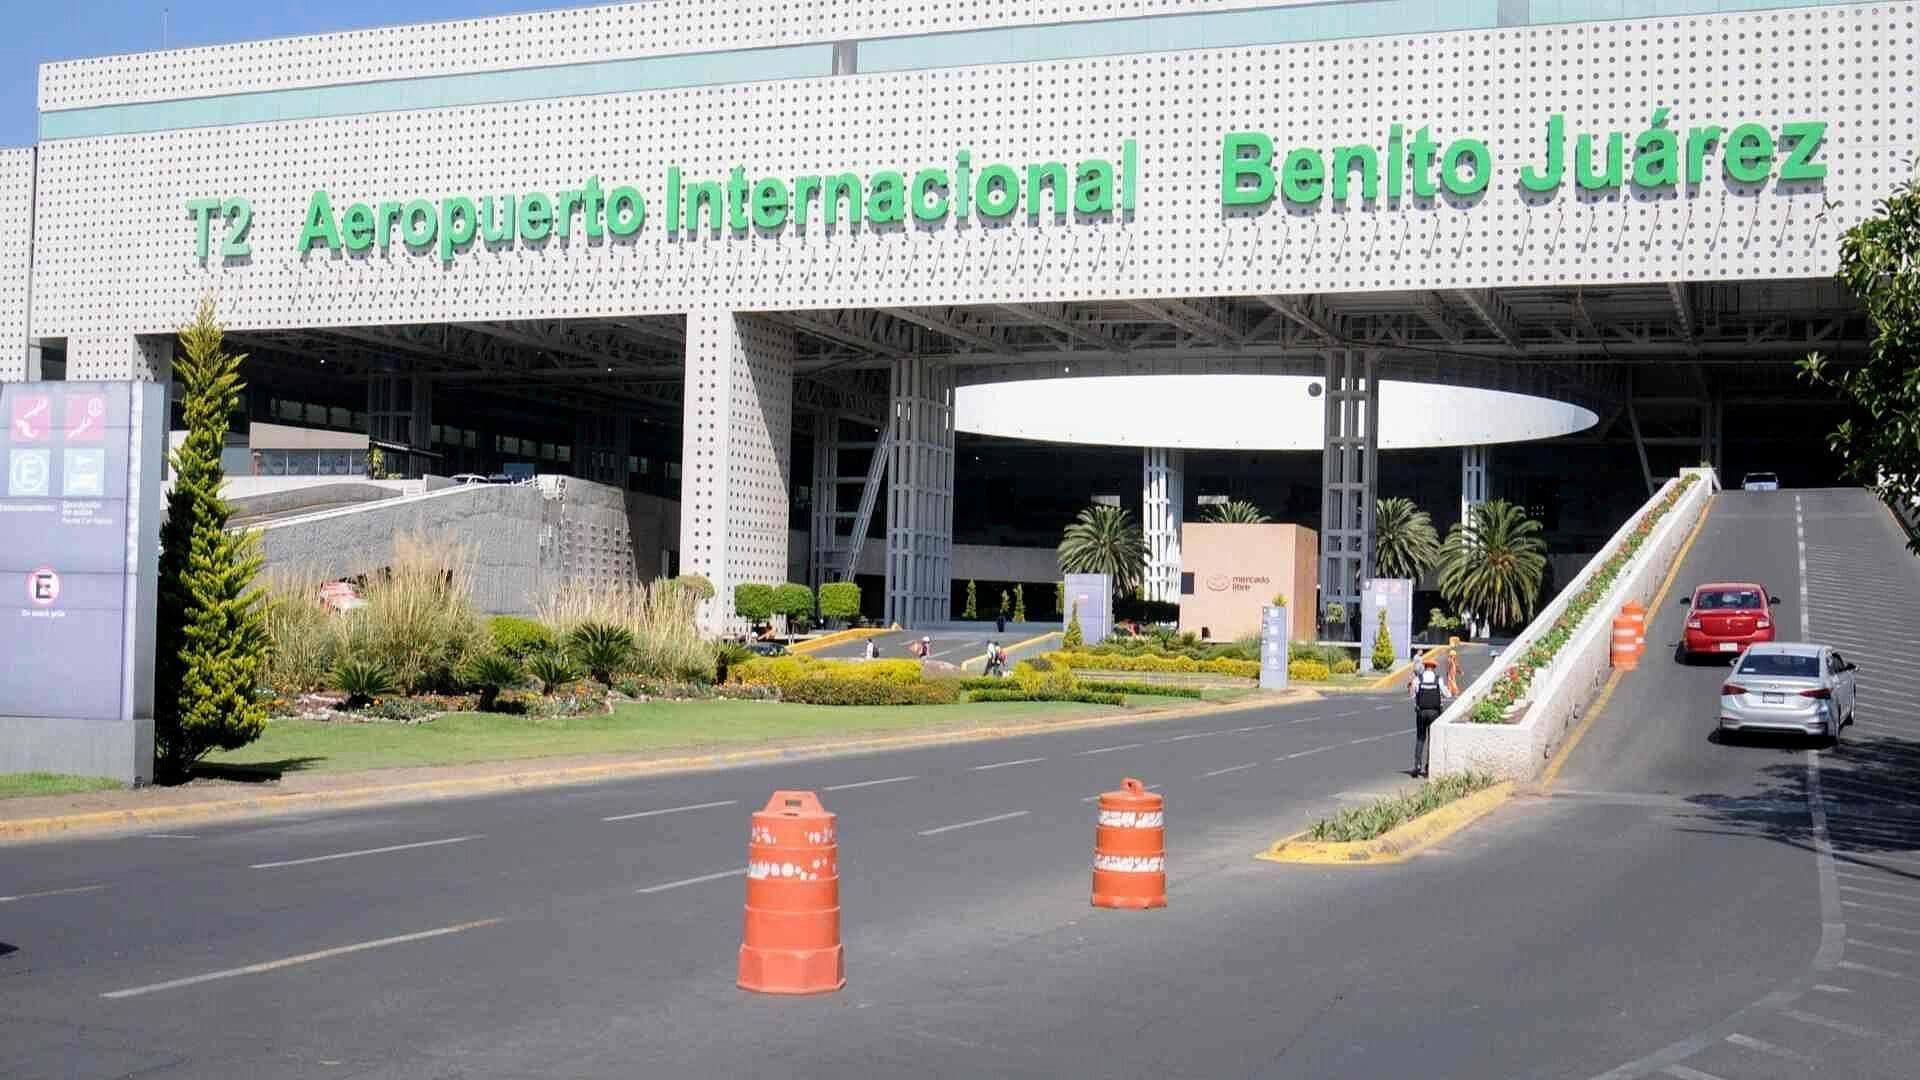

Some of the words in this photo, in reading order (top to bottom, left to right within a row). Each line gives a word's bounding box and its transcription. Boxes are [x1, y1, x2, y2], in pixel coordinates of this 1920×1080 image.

[187, 197, 252, 259] T2
[298, 176, 645, 264] Aeropuerto
[666, 139, 1137, 235] Internacional
[1222, 124, 1492, 207] Benito
[1520, 107, 1828, 194] Juárez
[36, 574, 52, 599] E
